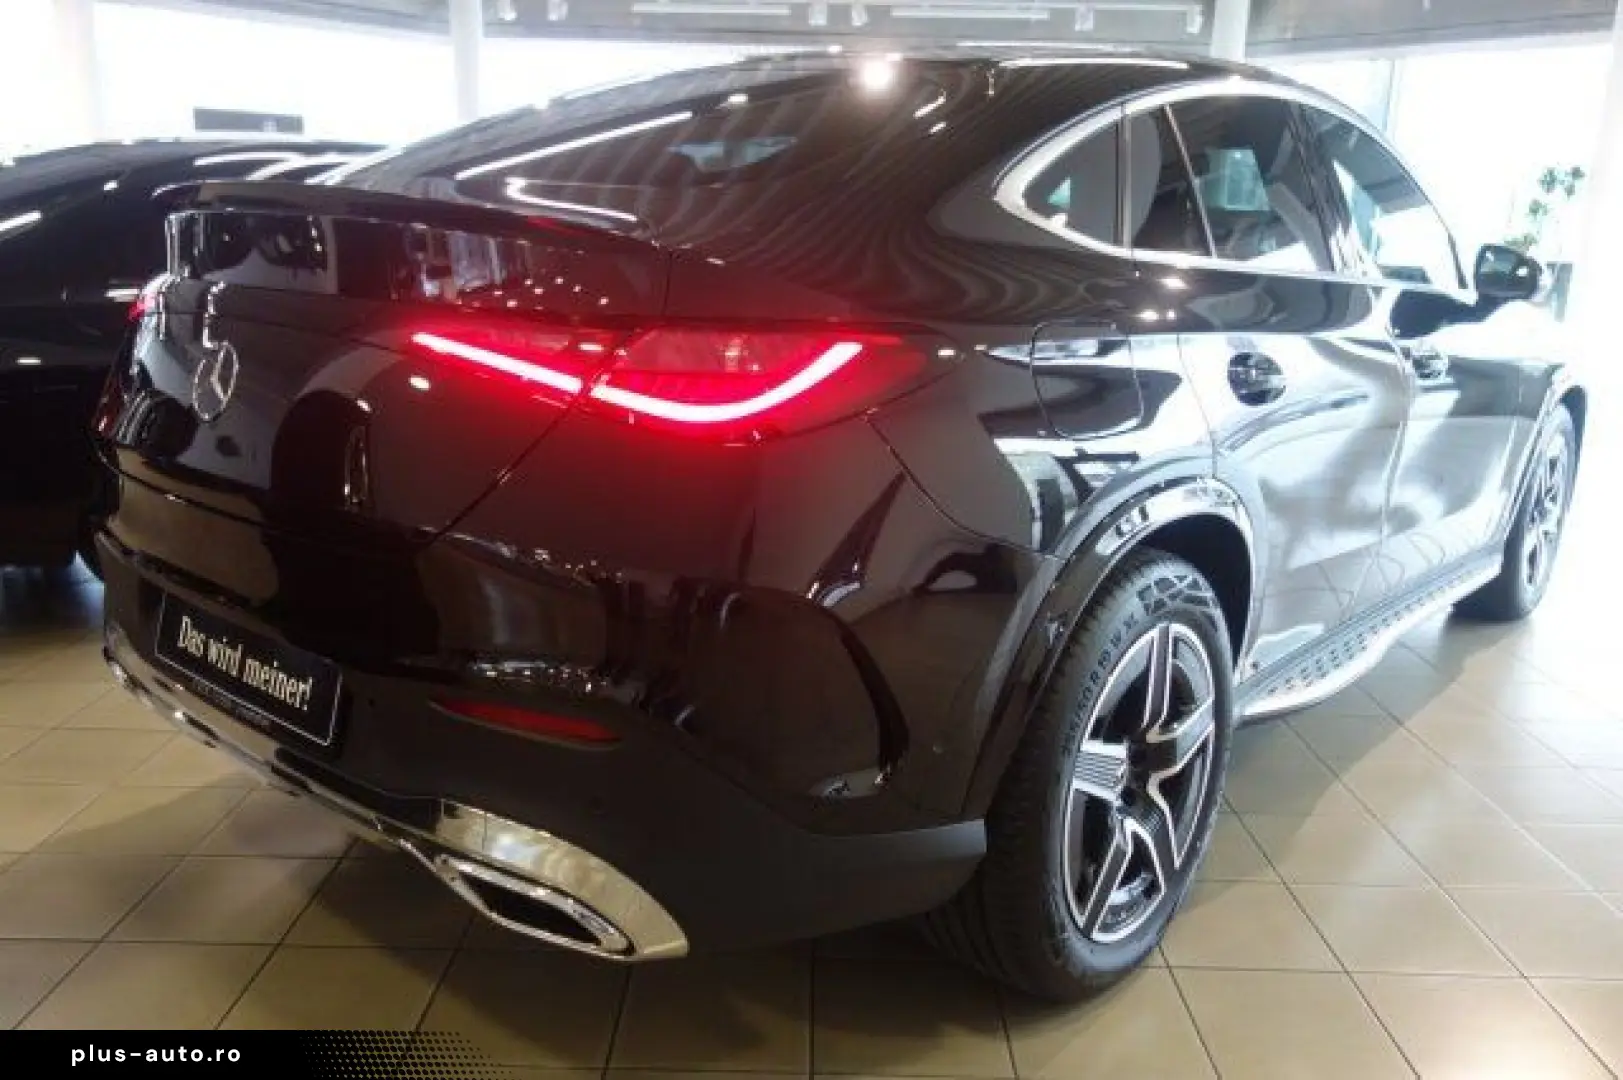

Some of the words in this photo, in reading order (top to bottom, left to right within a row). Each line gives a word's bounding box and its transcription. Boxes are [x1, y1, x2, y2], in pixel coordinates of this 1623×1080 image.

[177, 615, 206, 657] Das
[207, 636, 244, 677] wird
[243, 659, 313, 711] meiner!
